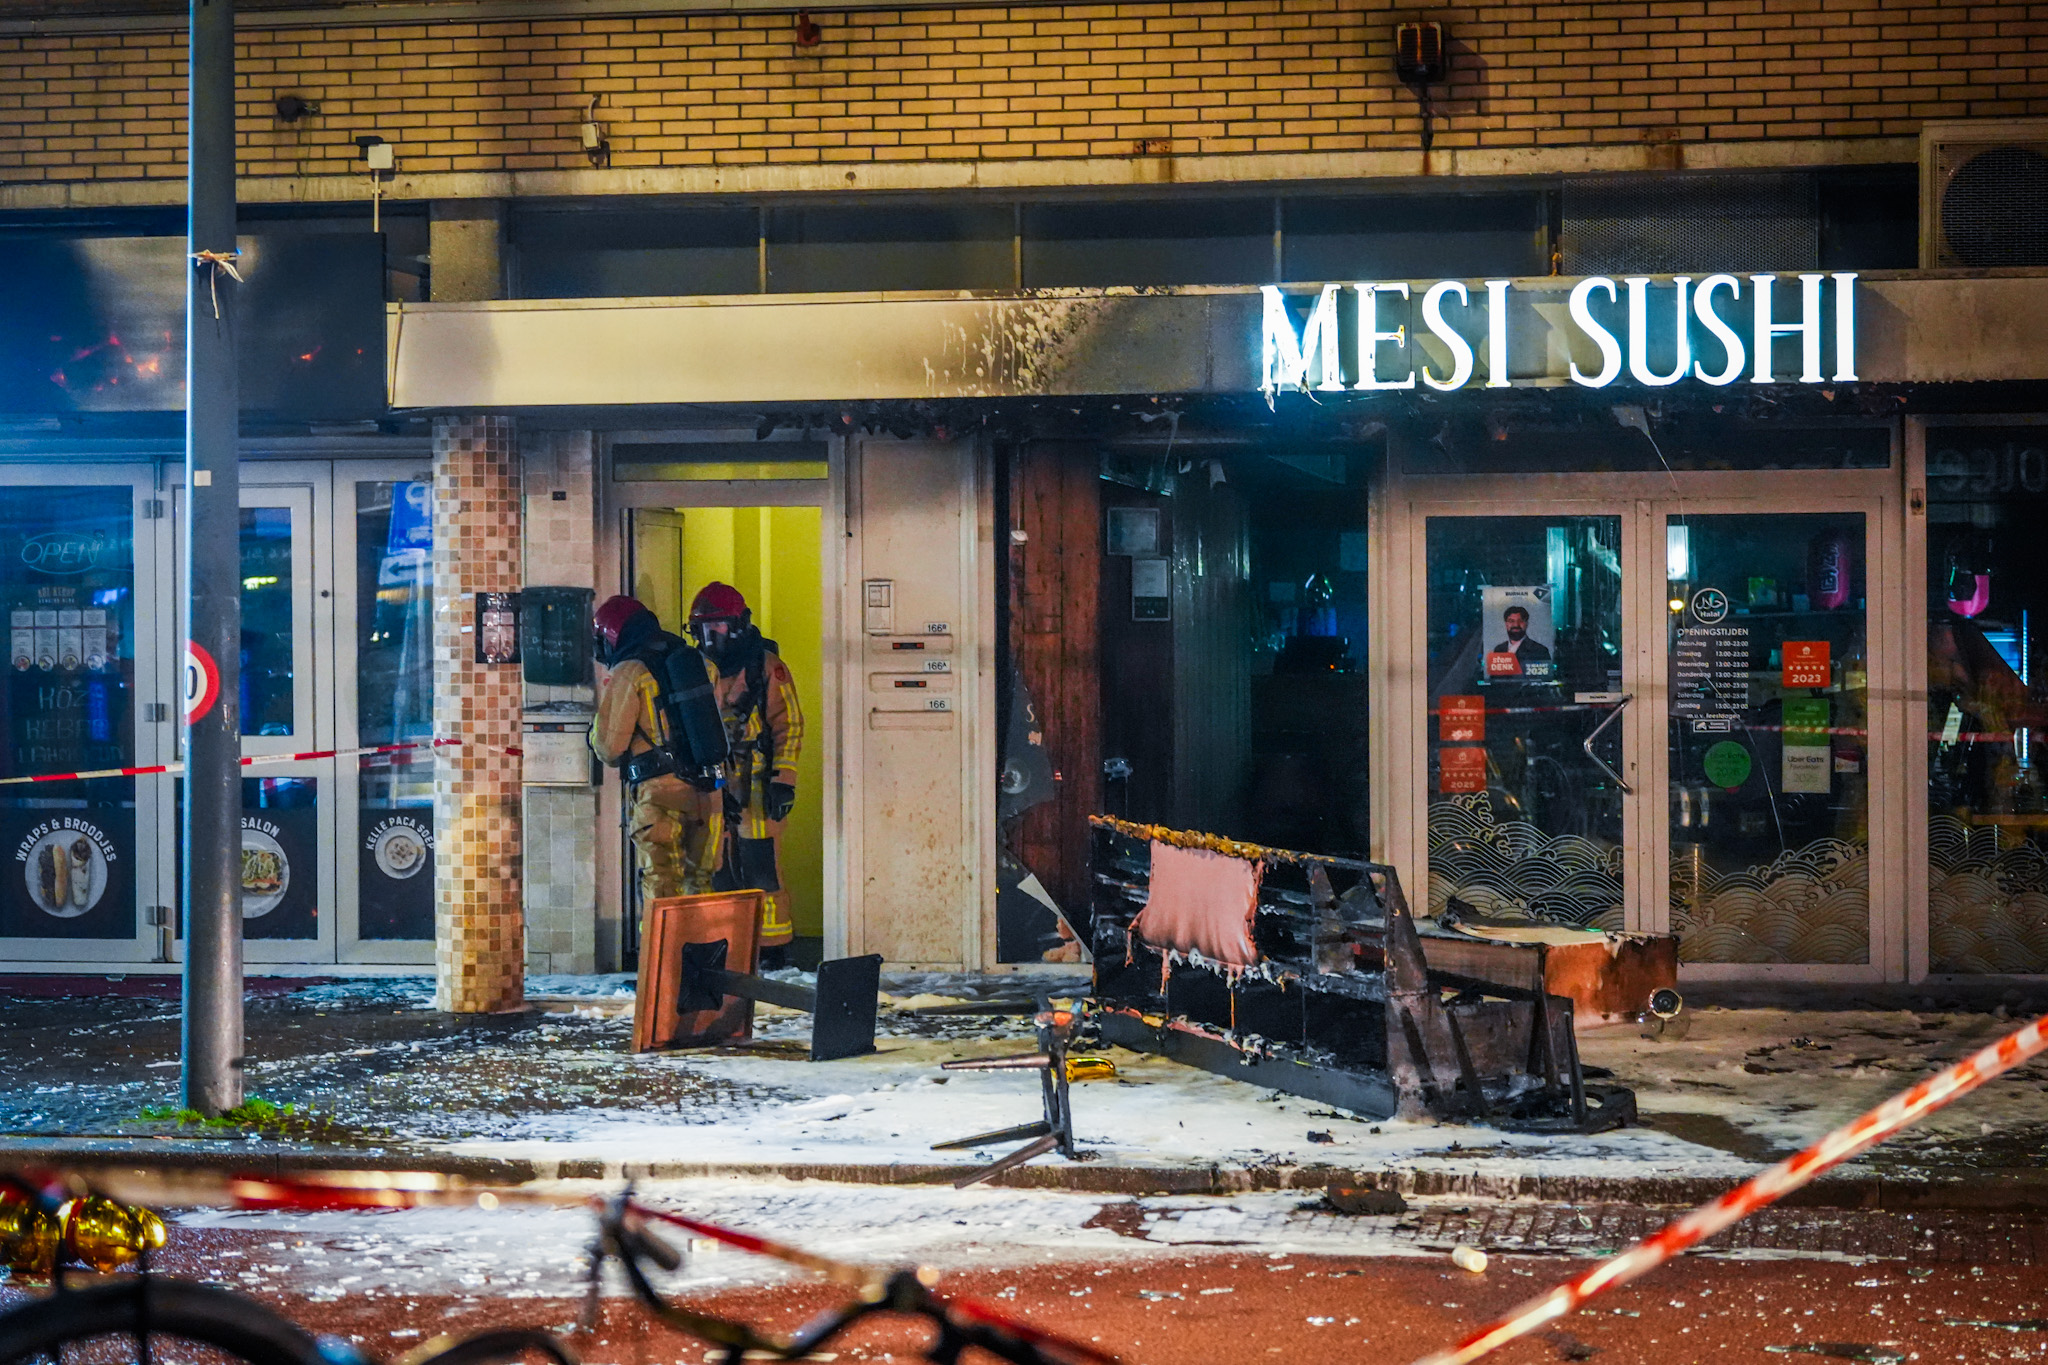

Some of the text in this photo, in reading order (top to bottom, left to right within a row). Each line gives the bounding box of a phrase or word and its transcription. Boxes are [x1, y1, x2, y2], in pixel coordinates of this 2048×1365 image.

[1259, 272, 1860, 393] MESI SUSHI
[22, 541, 102, 564] OPEN
[1695, 596, 1725, 610] حلال
[1700, 610, 1721, 618] Halal
[1677, 627, 1749, 637] OPENINGSTIJDEN
[1492, 655, 1512, 664] stem
[1525, 667, 1549, 675] 2026
[1677, 671, 1712, 679] Donderdag
[1792, 674, 1822, 684] 2023
[929, 700, 946, 709] 166
[1677, 702, 1701, 710] Zondag
[1787, 755, 1825, 763] Uber Eats
[1450, 781, 1476, 789] 2025
[240, 816, 281, 838] SALON
[365, 815, 434, 851] KELLE PACA SOEP
[15, 816, 117, 862] WRAPS & BROODJES
